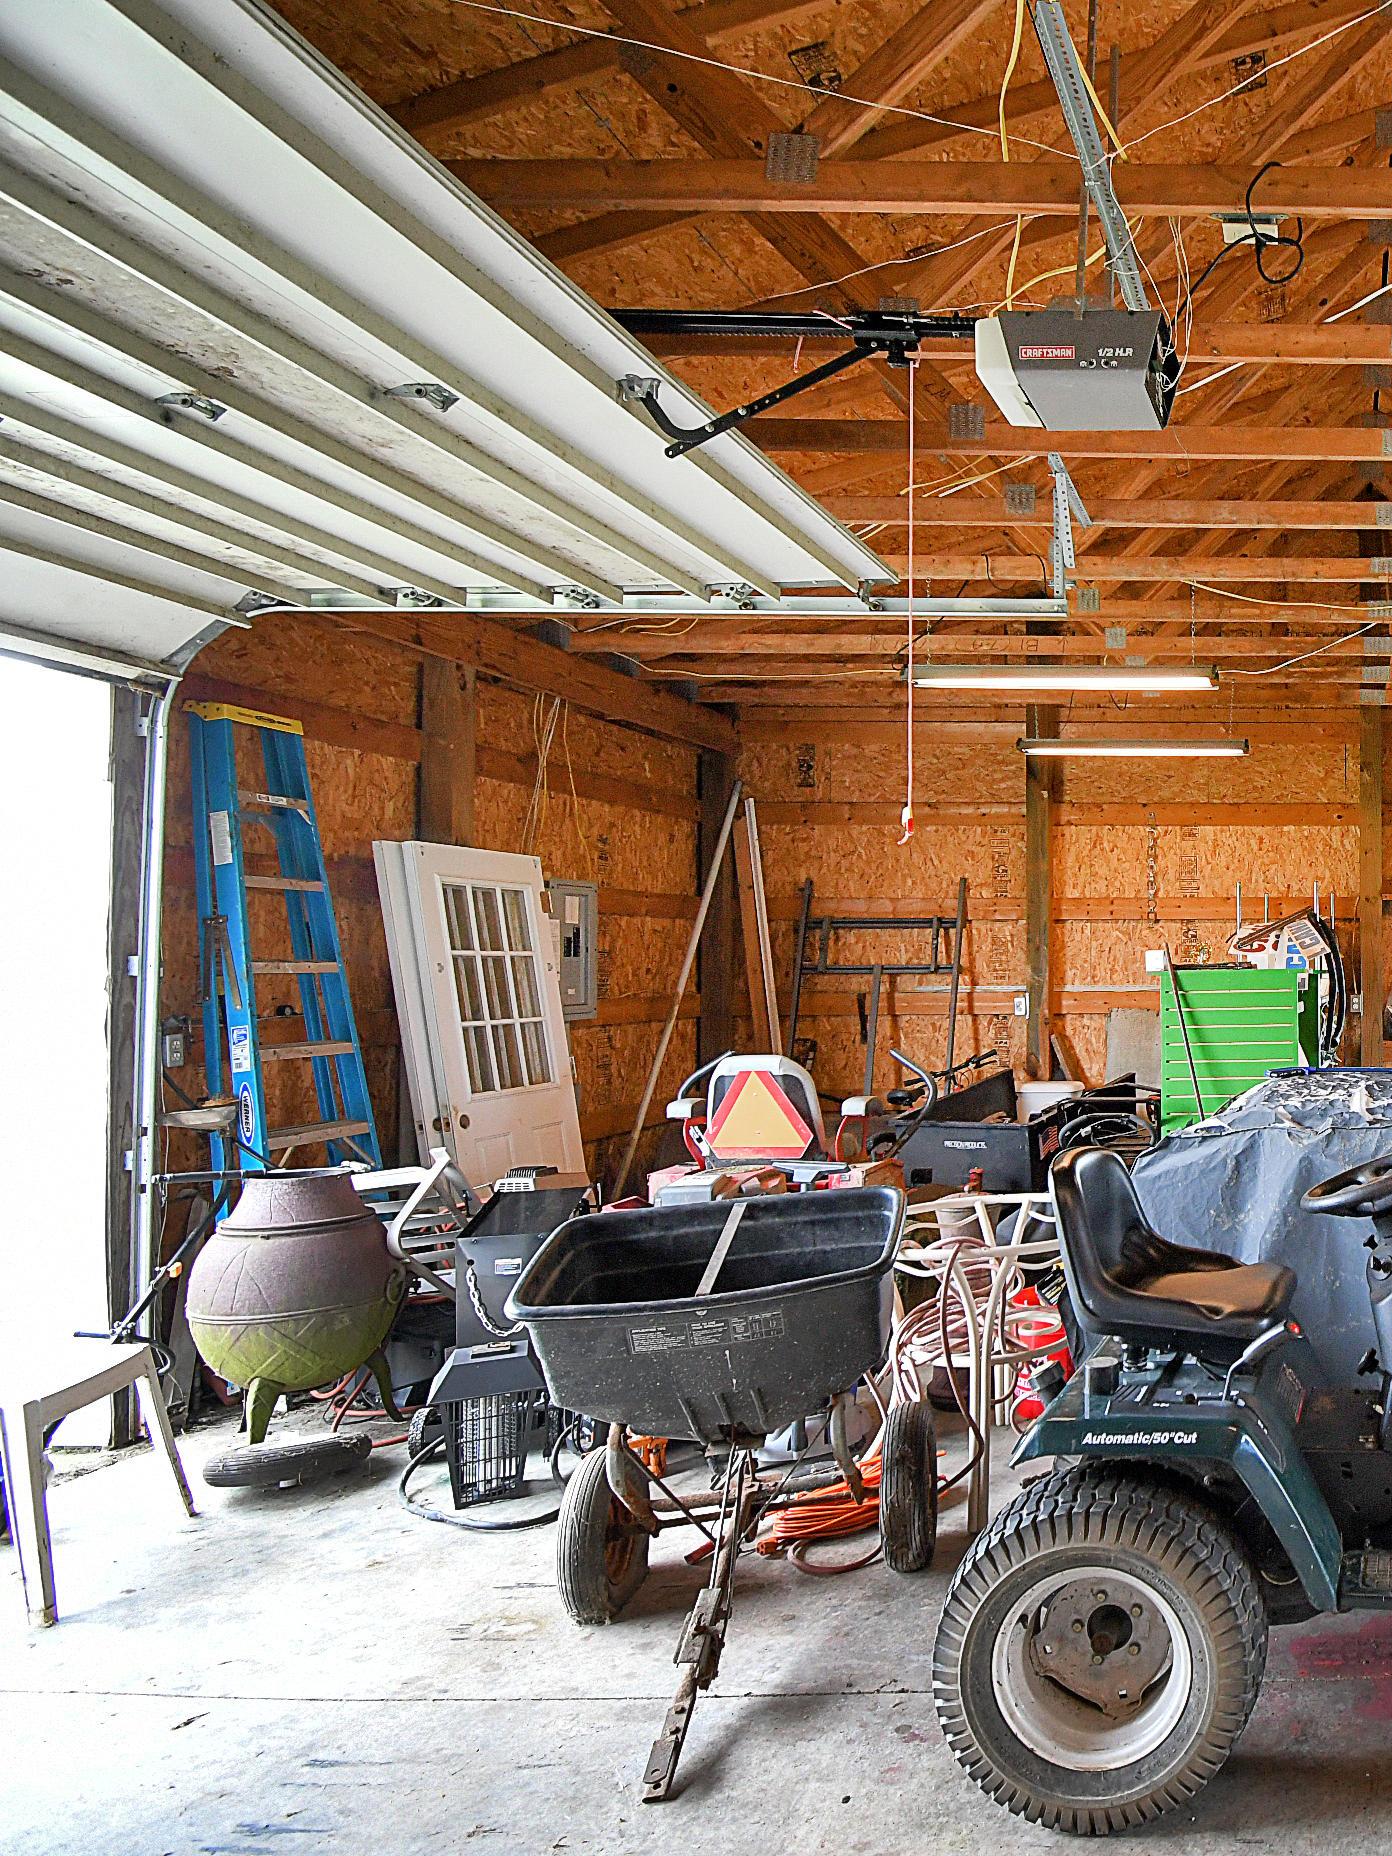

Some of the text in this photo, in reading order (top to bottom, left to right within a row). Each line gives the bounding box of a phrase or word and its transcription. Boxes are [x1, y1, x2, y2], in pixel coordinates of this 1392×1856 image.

[1021, 348, 1073, 358] CRAFTSMAN
[1097, 347, 1114, 357] 1/2
[242, 1095, 251, 1133] WERNER
